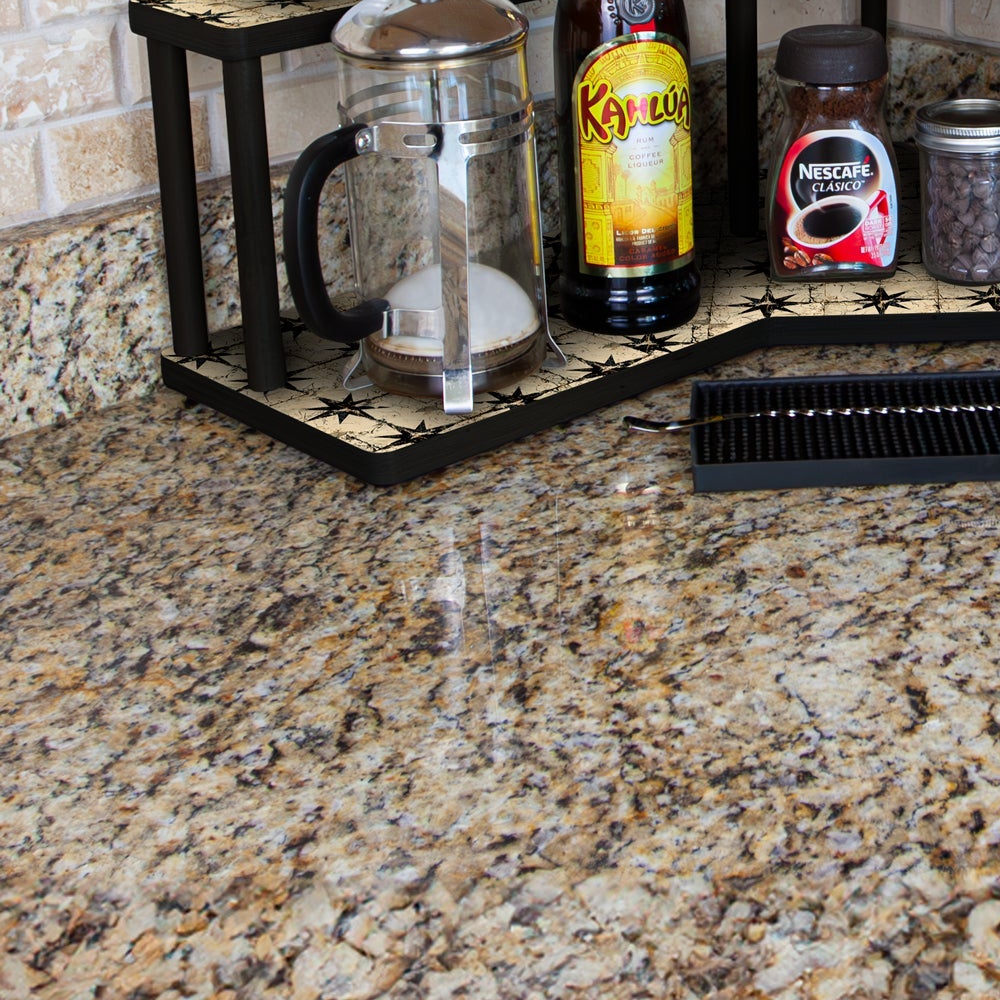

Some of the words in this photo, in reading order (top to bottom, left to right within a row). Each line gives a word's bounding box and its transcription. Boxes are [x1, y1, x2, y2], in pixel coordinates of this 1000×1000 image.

[579, 81, 690, 142] KAHLÚA
[636, 136, 654, 144] RUM
[629, 151, 662, 161] COFFEE
[627, 160, 664, 169] LIQUEUR
